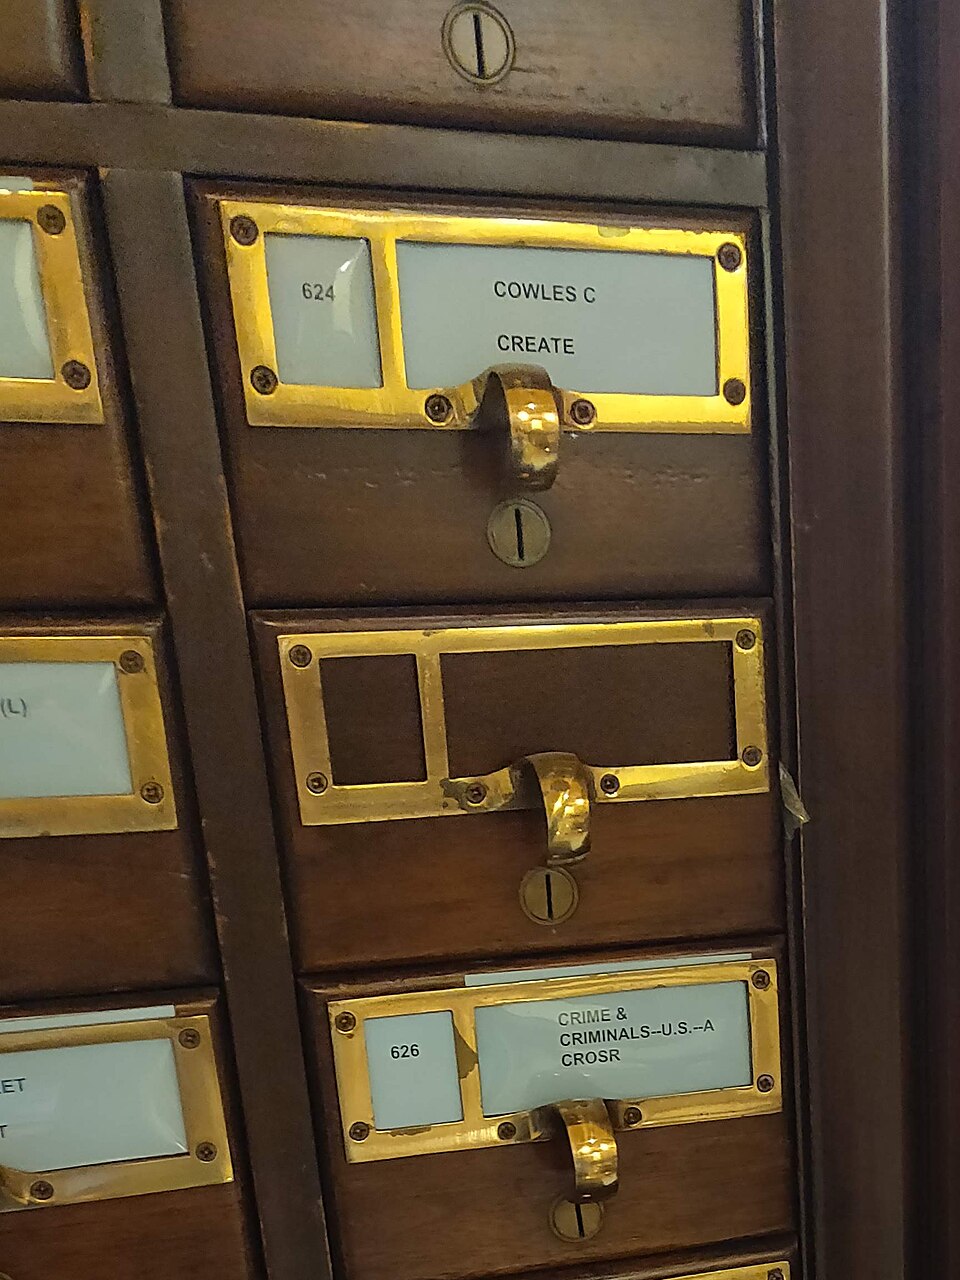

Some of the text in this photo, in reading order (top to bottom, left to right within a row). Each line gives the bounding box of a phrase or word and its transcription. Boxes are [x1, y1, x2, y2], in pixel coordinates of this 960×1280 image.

[301, 281, 336, 301] 624
[493, 280, 596, 304] COWLES C
[496, 334, 575, 355] CREATE
[558, 1007, 627, 1027] CRIME &
[390, 1043, 420, 1060] 626
[561, 1049, 621, 1067] CROSR
[0, 1078, 26, 1094] ET
